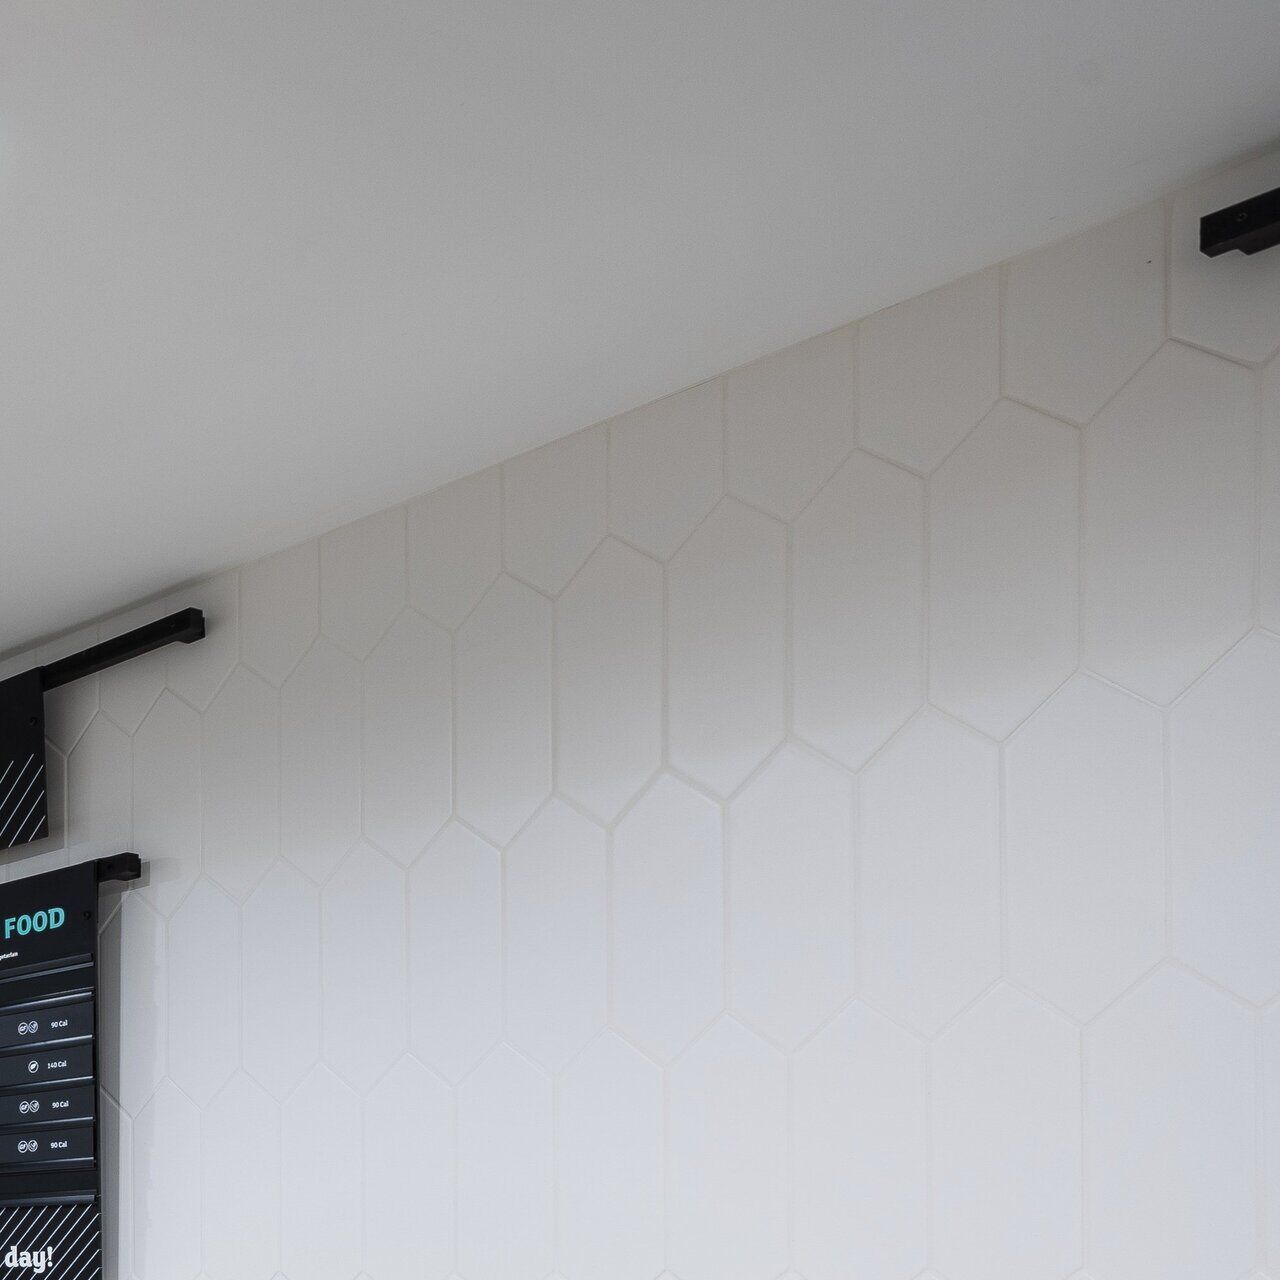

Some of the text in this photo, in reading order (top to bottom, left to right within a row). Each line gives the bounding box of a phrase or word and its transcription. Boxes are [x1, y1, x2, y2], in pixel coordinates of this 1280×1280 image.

[4, 907, 65, 939] FOOD
[58, 1060, 67, 1068] Cal
[5, 1246, 53, 1274] day!
